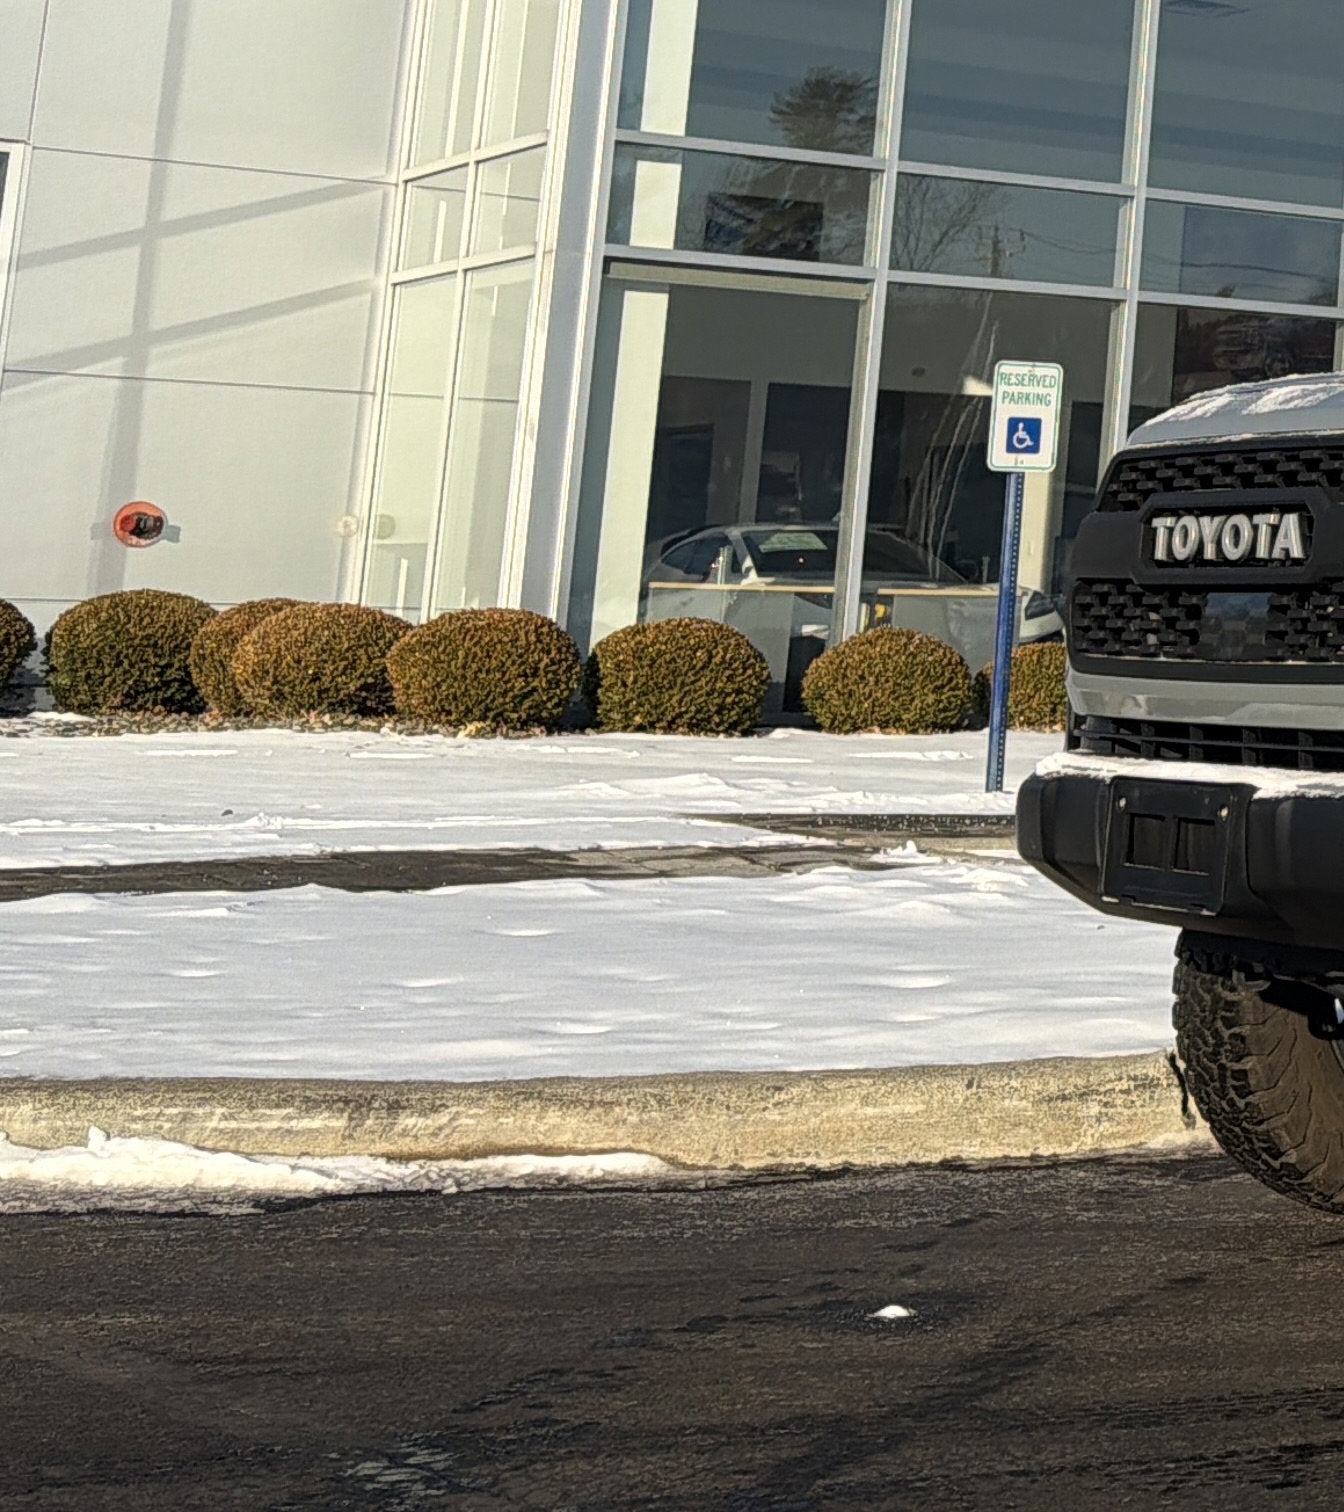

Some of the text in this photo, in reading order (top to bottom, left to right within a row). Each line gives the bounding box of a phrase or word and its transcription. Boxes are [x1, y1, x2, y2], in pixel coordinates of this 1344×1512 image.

[999, 371, 1057, 389] RESERVED
[1001, 390, 1052, 407] PARKING
[1151, 511, 1305, 562] TOYOTA
